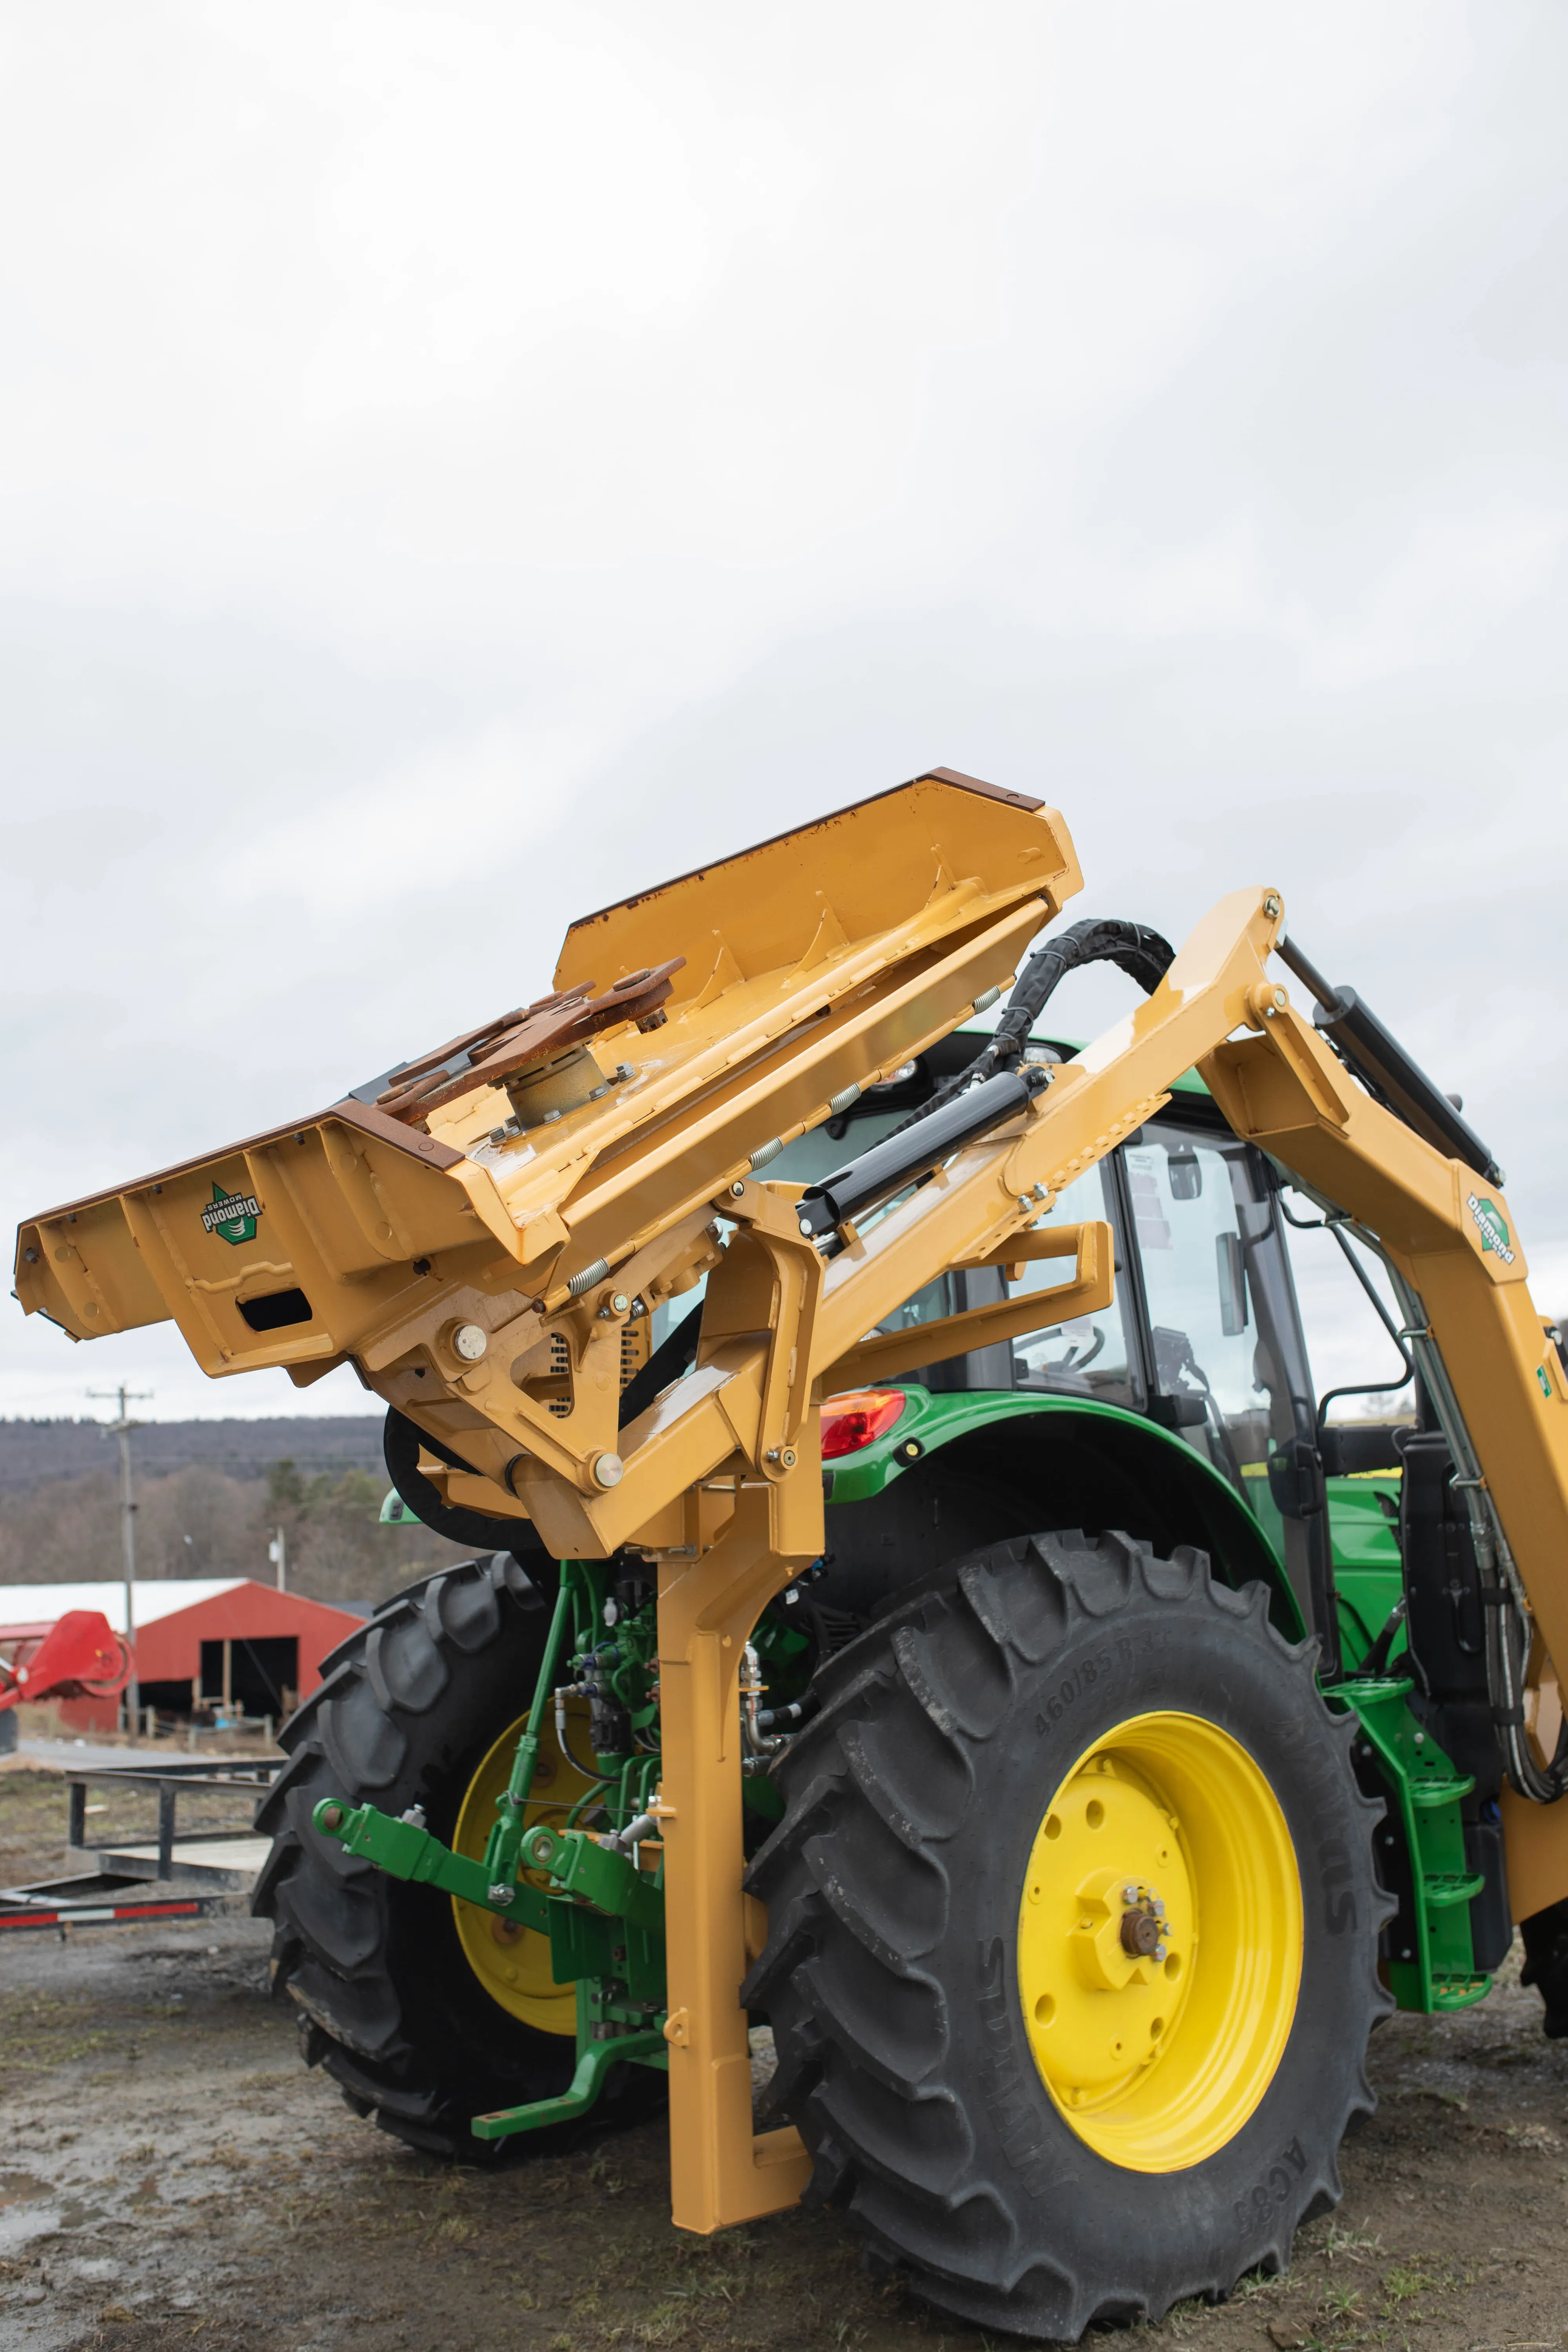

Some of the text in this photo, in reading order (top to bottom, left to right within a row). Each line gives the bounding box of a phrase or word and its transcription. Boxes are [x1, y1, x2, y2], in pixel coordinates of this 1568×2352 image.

[202, 1197, 261, 1231] Diamond
[207, 1194, 242, 1211] MOWERS
[1468, 1194, 1515, 1265] Diamond
